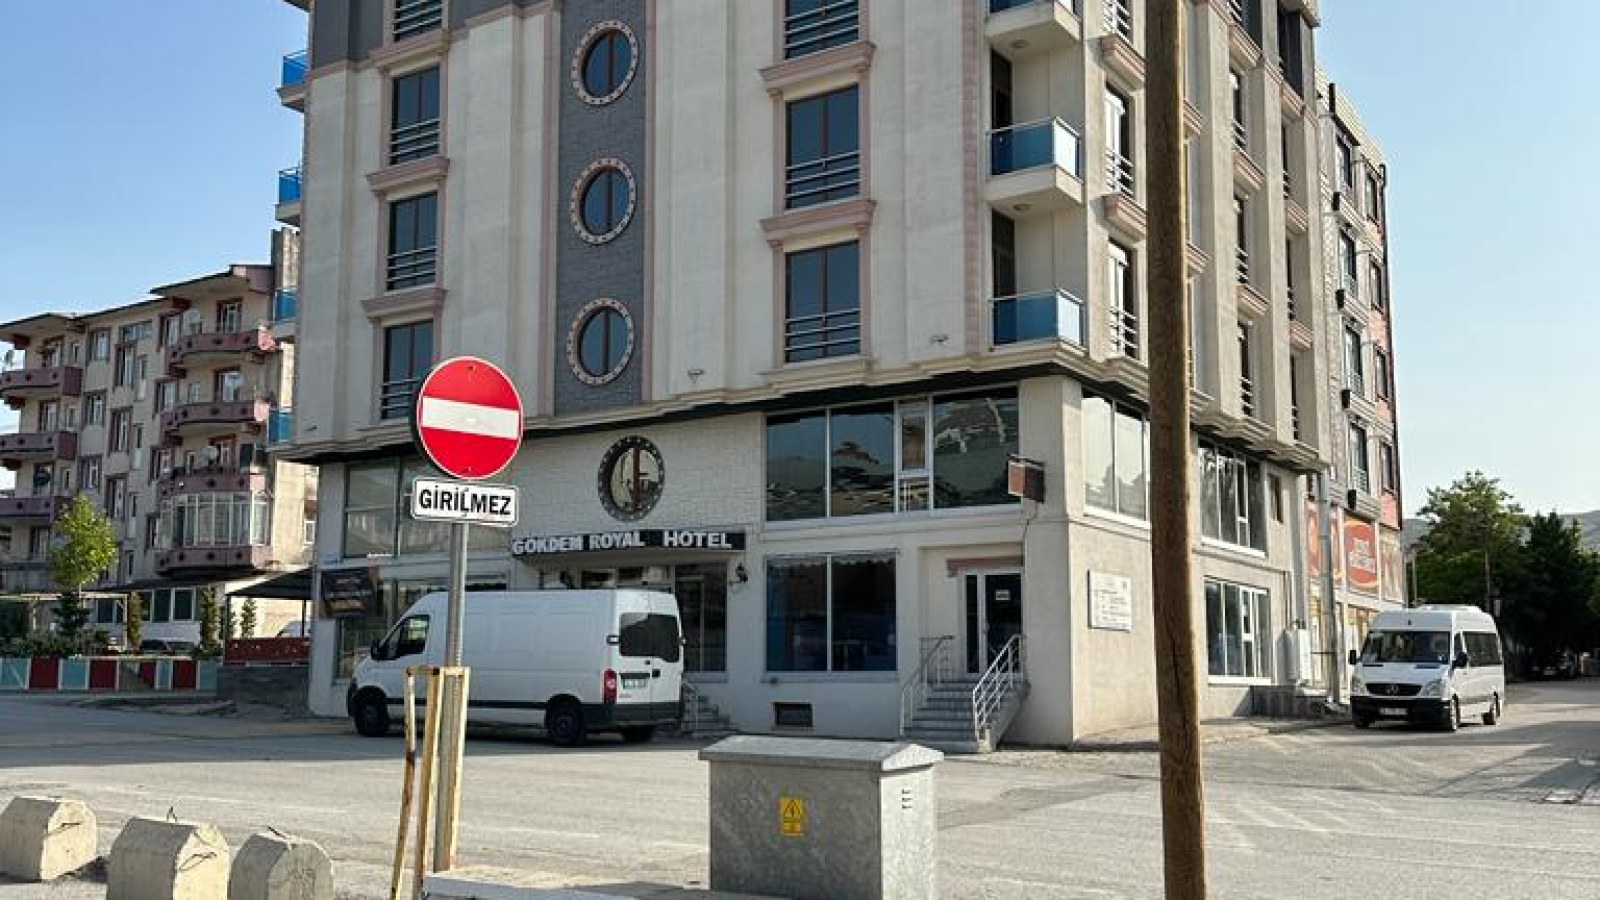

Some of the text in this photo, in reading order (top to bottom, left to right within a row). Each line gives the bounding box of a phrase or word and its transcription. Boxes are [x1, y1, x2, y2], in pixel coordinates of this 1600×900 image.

[419, 484, 511, 515] GİRİLMEZ
[589, 531, 645, 549] ROYAL
[664, 530, 732, 548] HOTEL
